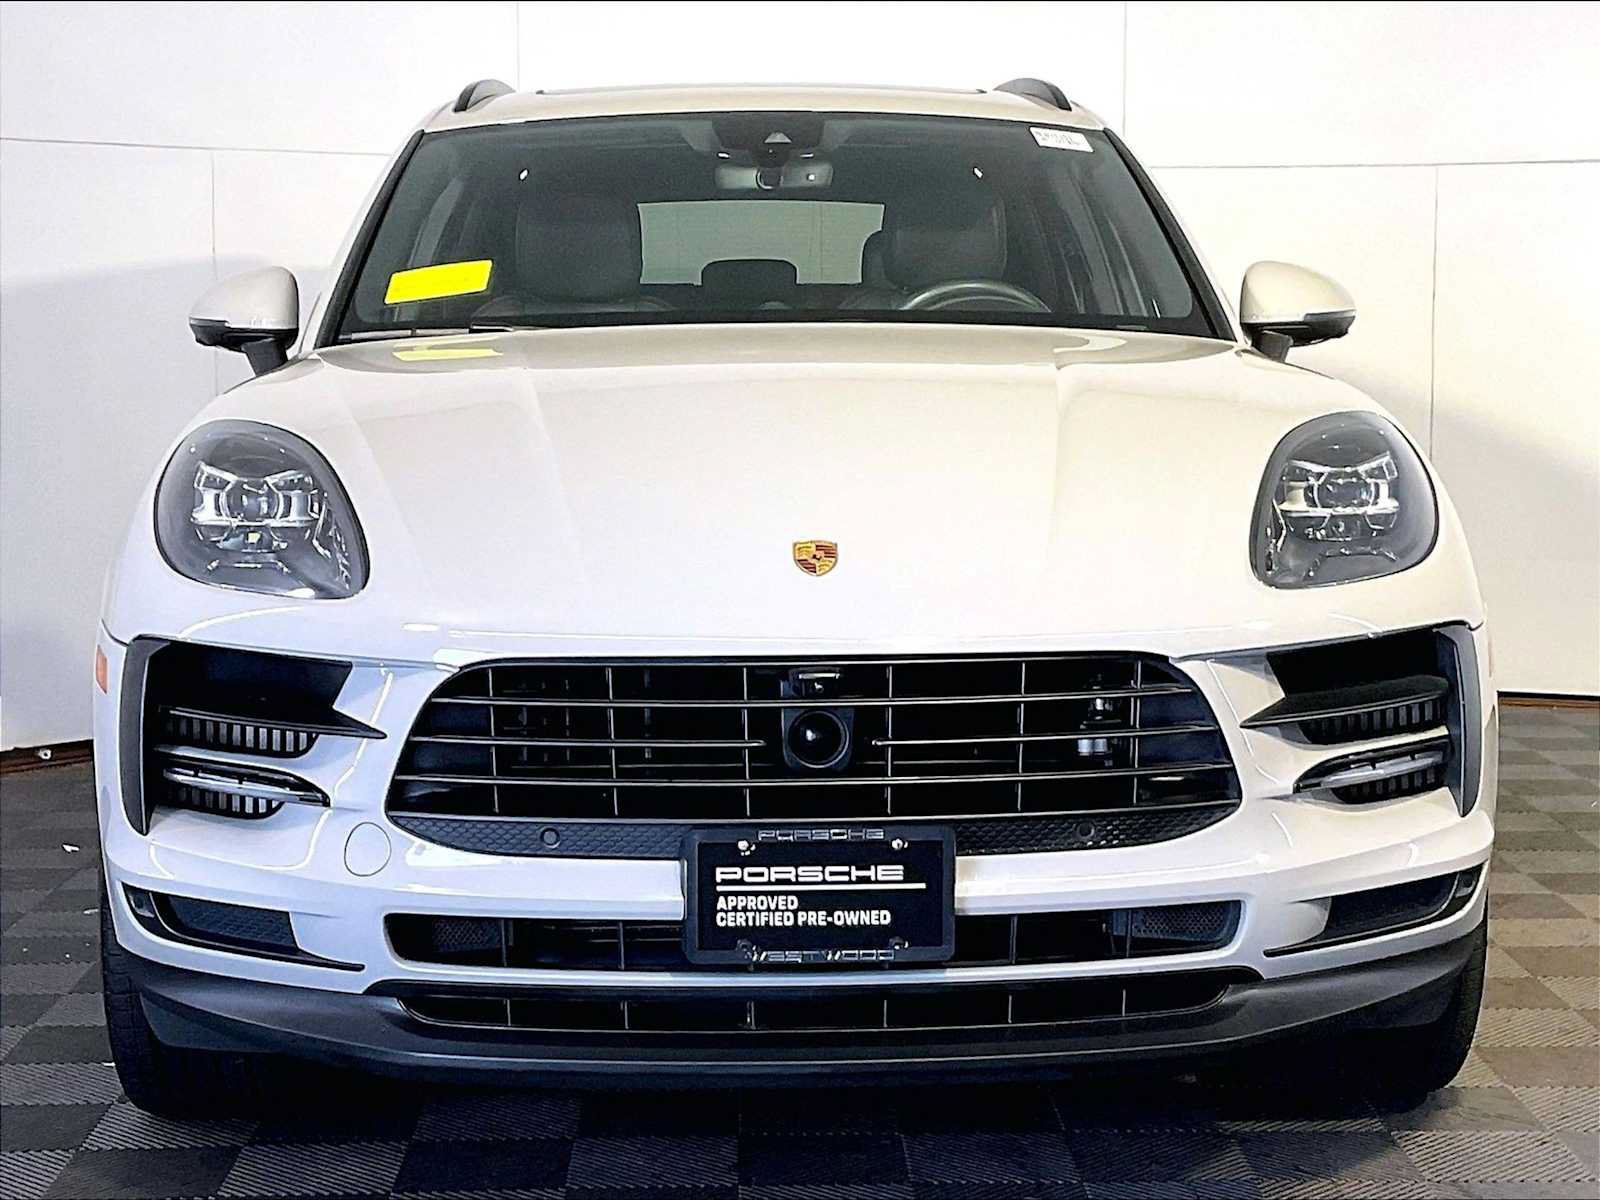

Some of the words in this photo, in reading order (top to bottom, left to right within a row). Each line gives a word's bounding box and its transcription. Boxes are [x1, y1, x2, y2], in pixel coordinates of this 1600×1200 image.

[758, 828, 884, 841] PORSCHE
[715, 865, 904, 883] PORSCHE
[716, 895, 799, 910] APPROVED
[716, 911, 794, 927] CERTIFIED
[797, 909, 892, 926] PRE-OWNED
[748, 949, 895, 963] WESTWOOD
